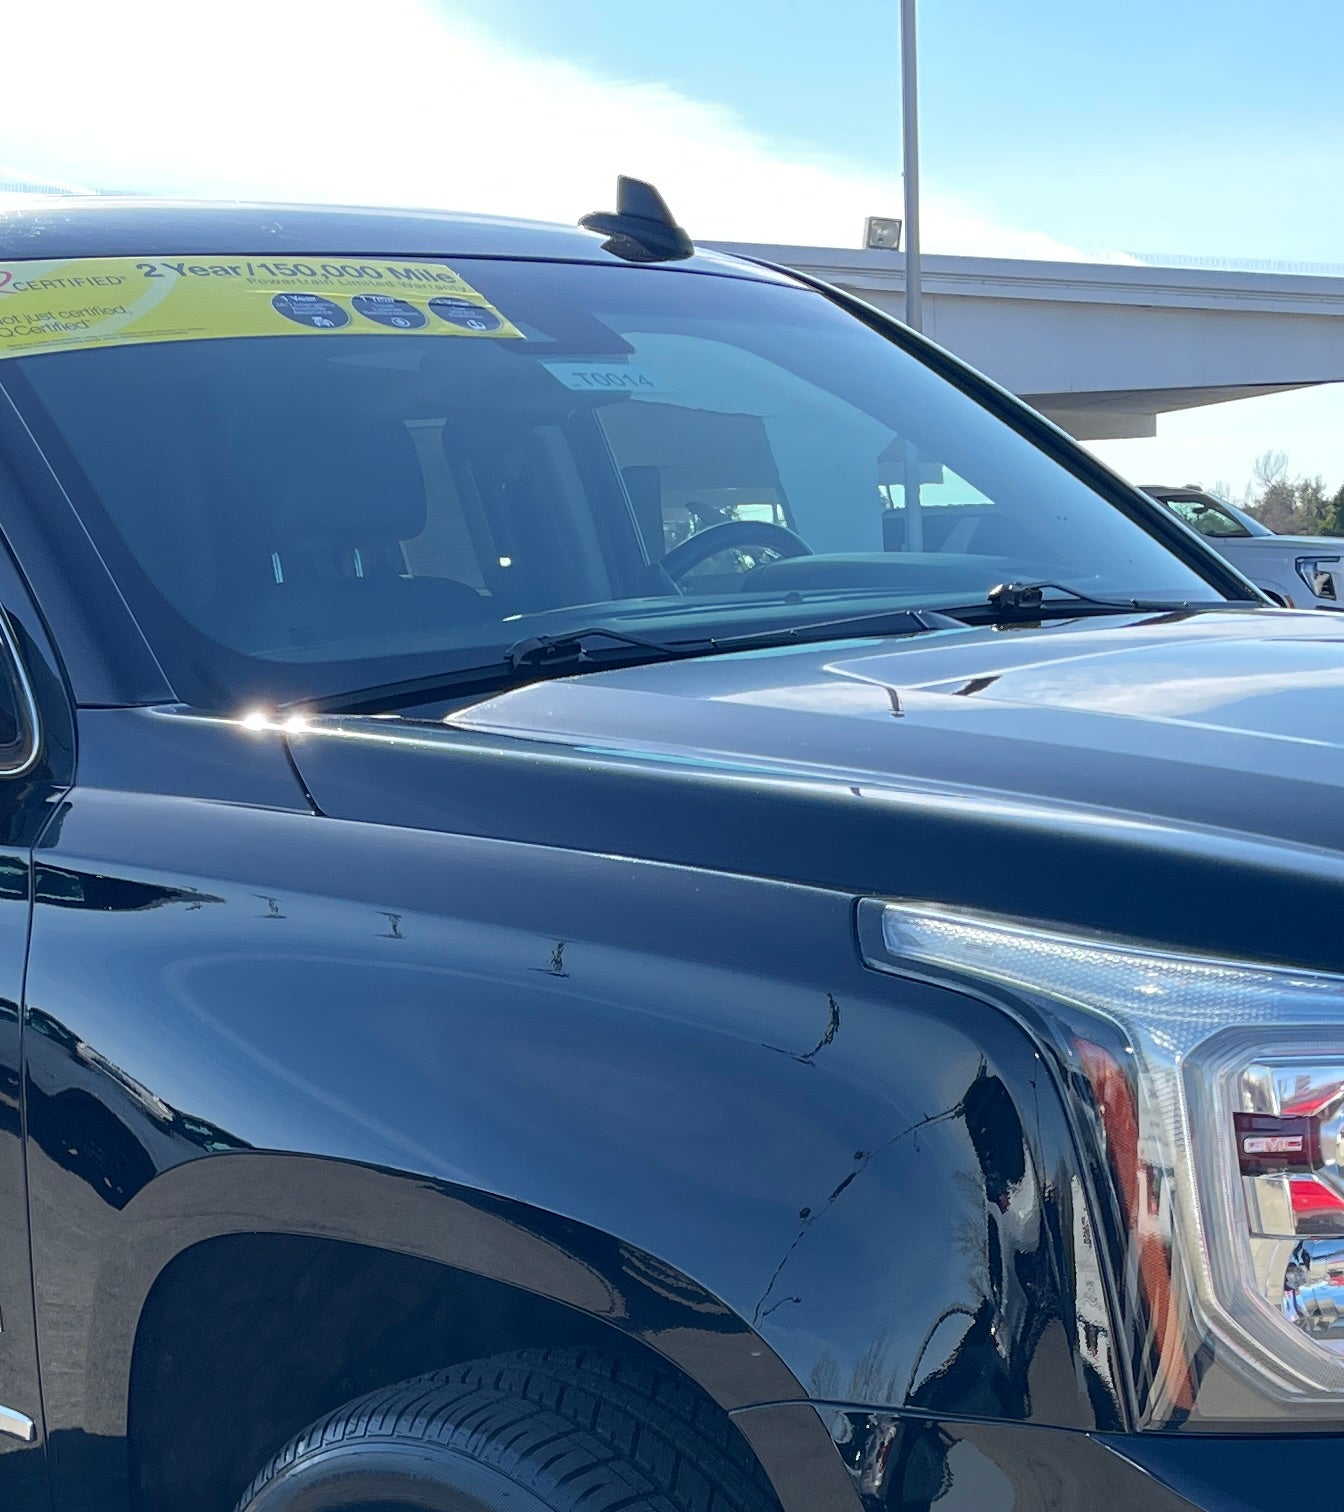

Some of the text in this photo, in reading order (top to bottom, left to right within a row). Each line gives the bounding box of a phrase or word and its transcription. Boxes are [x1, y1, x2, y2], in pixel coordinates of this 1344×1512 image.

[135, 263, 165, 278] 2
[386, 266, 456, 284] Mile
[246, 277, 334, 286] Powertrain
[338, 279, 396, 288] Limited
[22, 309, 57, 324] just
[571, 372, 654, 388] T0014
[1244, 1135, 1303, 1153] GMC
